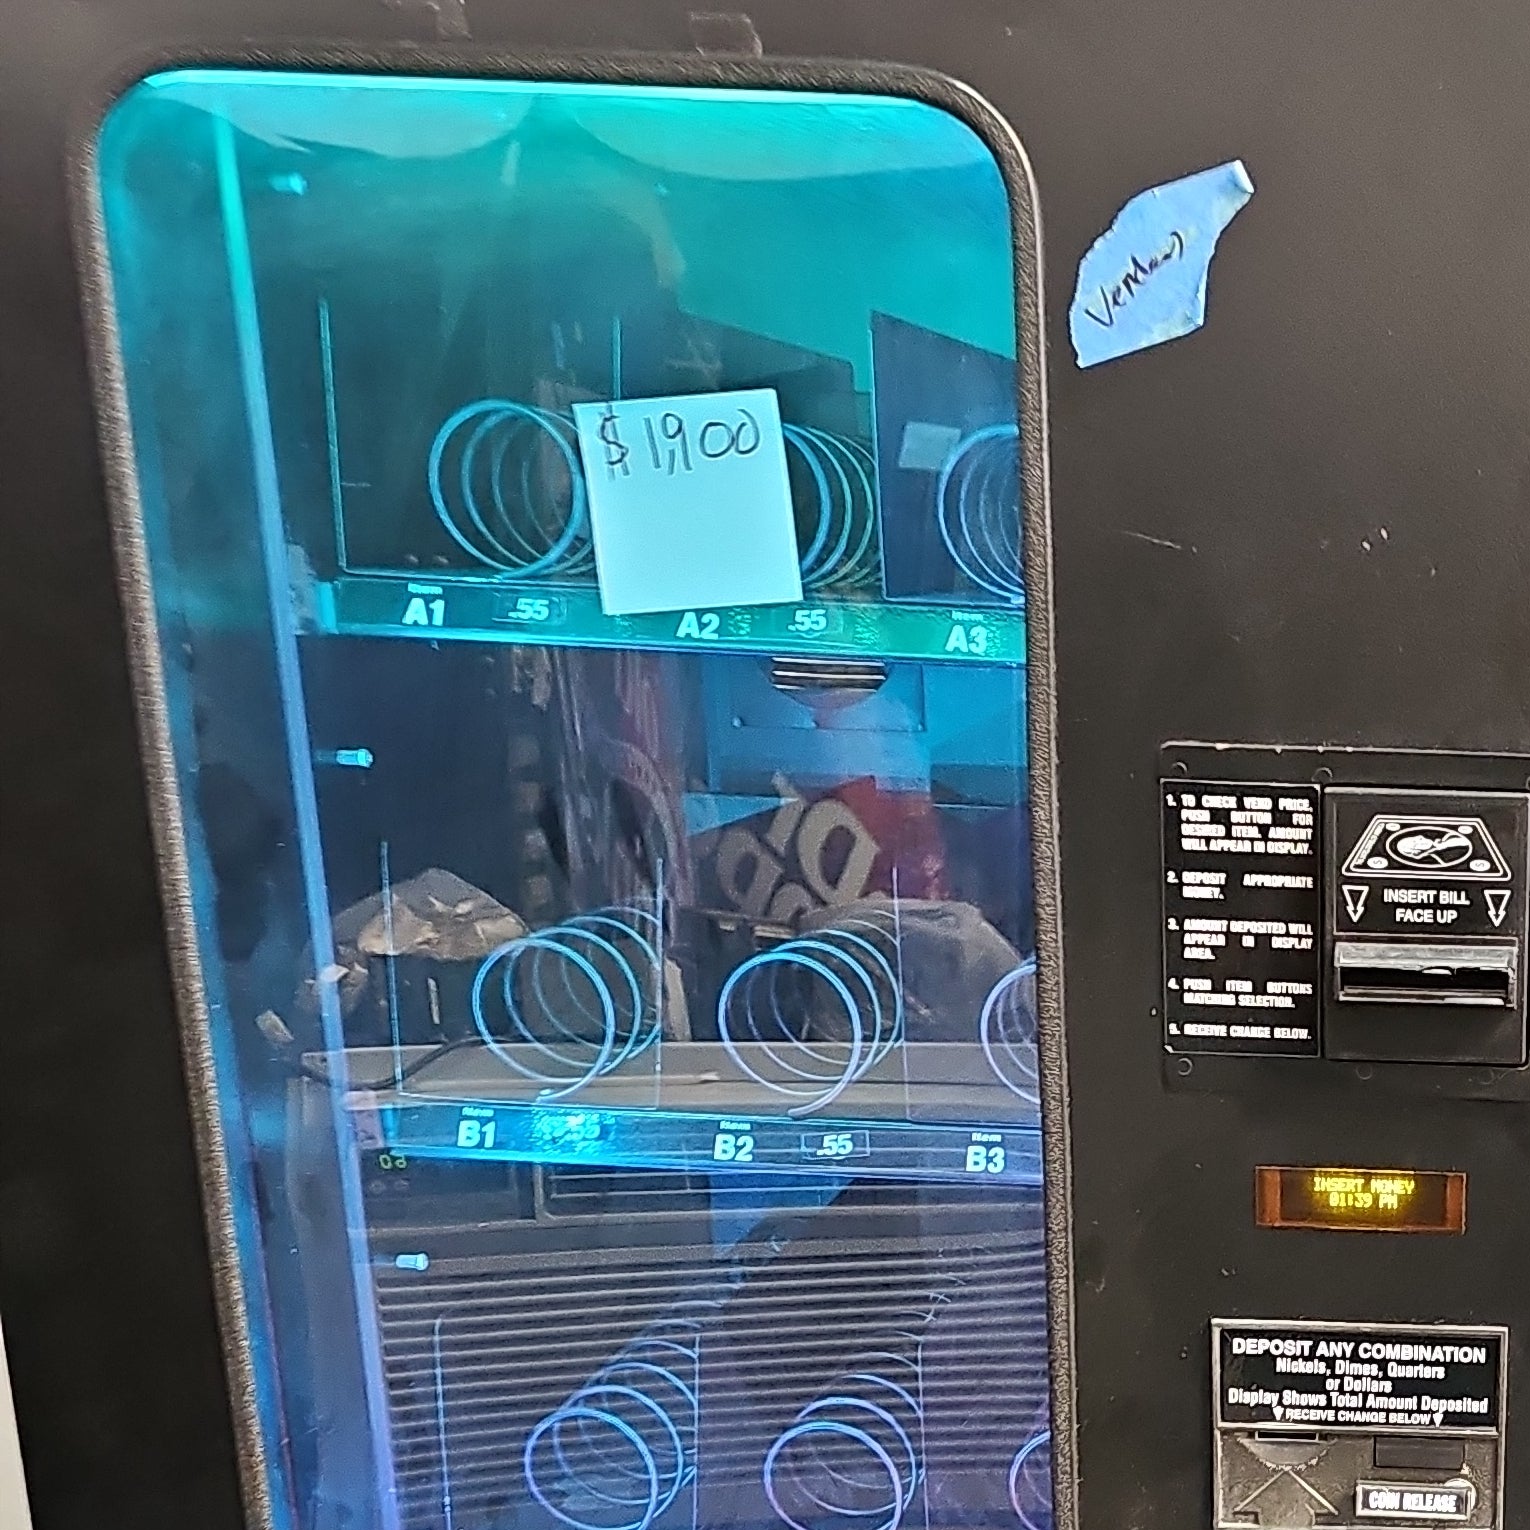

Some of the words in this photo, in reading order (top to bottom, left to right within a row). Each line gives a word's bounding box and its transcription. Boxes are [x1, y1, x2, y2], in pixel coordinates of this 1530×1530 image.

[402, 597, 446, 626] A1
[508, 598, 550, 621] .55
[675, 611, 720, 640] A2
[787, 609, 827, 632] .55
[945, 624, 989, 655] A3
[1231, 811, 1272, 824] BUTTON
[1292, 813, 1313, 826] FOR
[1268, 827, 1313, 840] AMOUNT
[1181, 838, 1208, 851] WILL
[1209, 839, 1251, 852] APPEAR
[1182, 871, 1226, 885] DEPOSIT
[1243, 873, 1313, 888] APPROPRIATE
[1384, 888, 1438, 904] INSERT
[1439, 890, 1470, 905] BILL
[1396, 908, 1434, 923] FACE
[1437, 910, 1458, 923] UP
[1230, 920, 1286, 934] DEPOSITED
[1288, 923, 1313, 935] WILL
[1184, 933, 1225, 946] APPEAR
[1272, 936, 1313, 949] DISPLAY
[1267, 982, 1312, 994] BUTTONS
[1274, 1027, 1311, 1039] BELOW.
[456, 1119, 496, 1148] B1
[714, 1133, 755, 1162] B2
[816, 1133, 854, 1157] .55
[965, 1145, 1005, 1174] B3
[1313, 1176, 1365, 1192] INSERT
[1371, 1178, 1415, 1194] MONEY
[1379, 1194, 1398, 1209] PM
[1232, 1338, 1313, 1357] DEPOSIT
[1315, 1341, 1356, 1358] ANY
[1358, 1342, 1486, 1363] COMBINATION
[1276, 1357, 1331, 1375] Nickels,
[1335, 1360, 1383, 1378] Dimes,
[1387, 1362, 1445, 1379] Quarters
[1325, 1378, 1340, 1392] or
[1343, 1376, 1392, 1394] Dollars
[1228, 1387, 1280, 1408] Display
[1282, 1389, 1327, 1407] Shows
[1330, 1392, 1363, 1408] Total
[1366, 1395, 1418, 1410] Amount
[1421, 1396, 1489, 1416] Deposited
[1285, 1408, 1335, 1421] RECEIVE
[1338, 1410, 1386, 1423] CHANGE
[1388, 1412, 1431, 1425] BELOW
[1369, 1491, 1400, 1510] COIN
[1403, 1493, 1457, 1512] RELEASE
